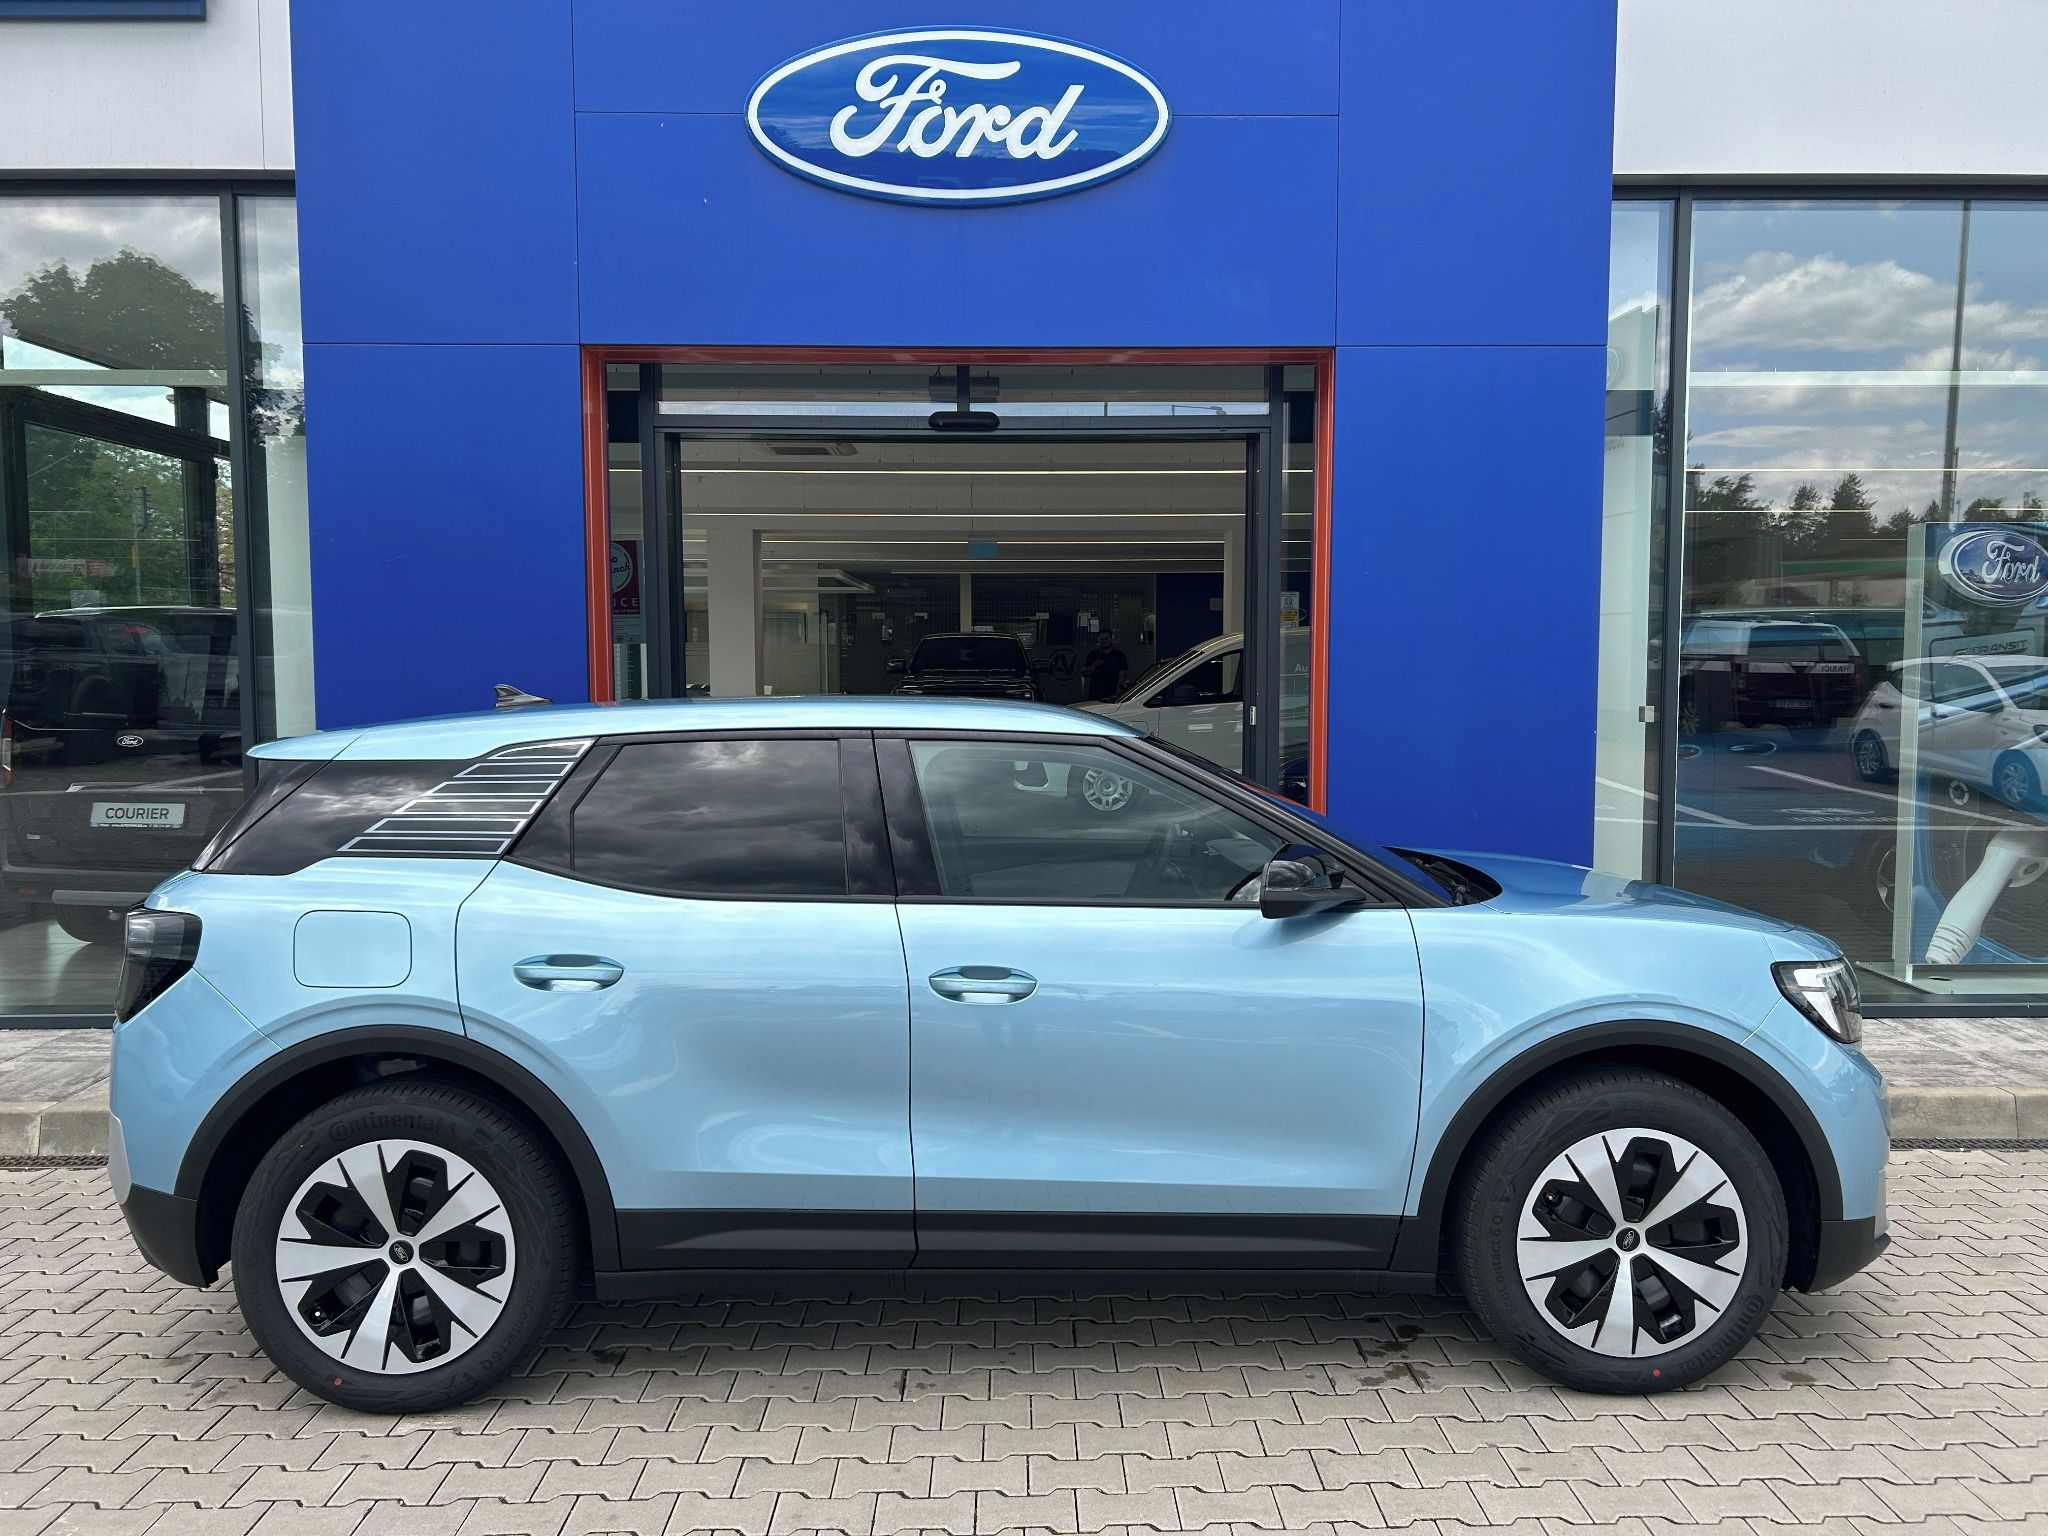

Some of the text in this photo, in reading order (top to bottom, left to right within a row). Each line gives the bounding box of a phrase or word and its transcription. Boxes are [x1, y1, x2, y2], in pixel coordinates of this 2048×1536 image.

[829, 55, 1085, 159] Ford
[1981, 540, 2040, 584] Ford
[105, 807, 169, 820] COURIER
[328, 1111, 443, 1142] Continental
